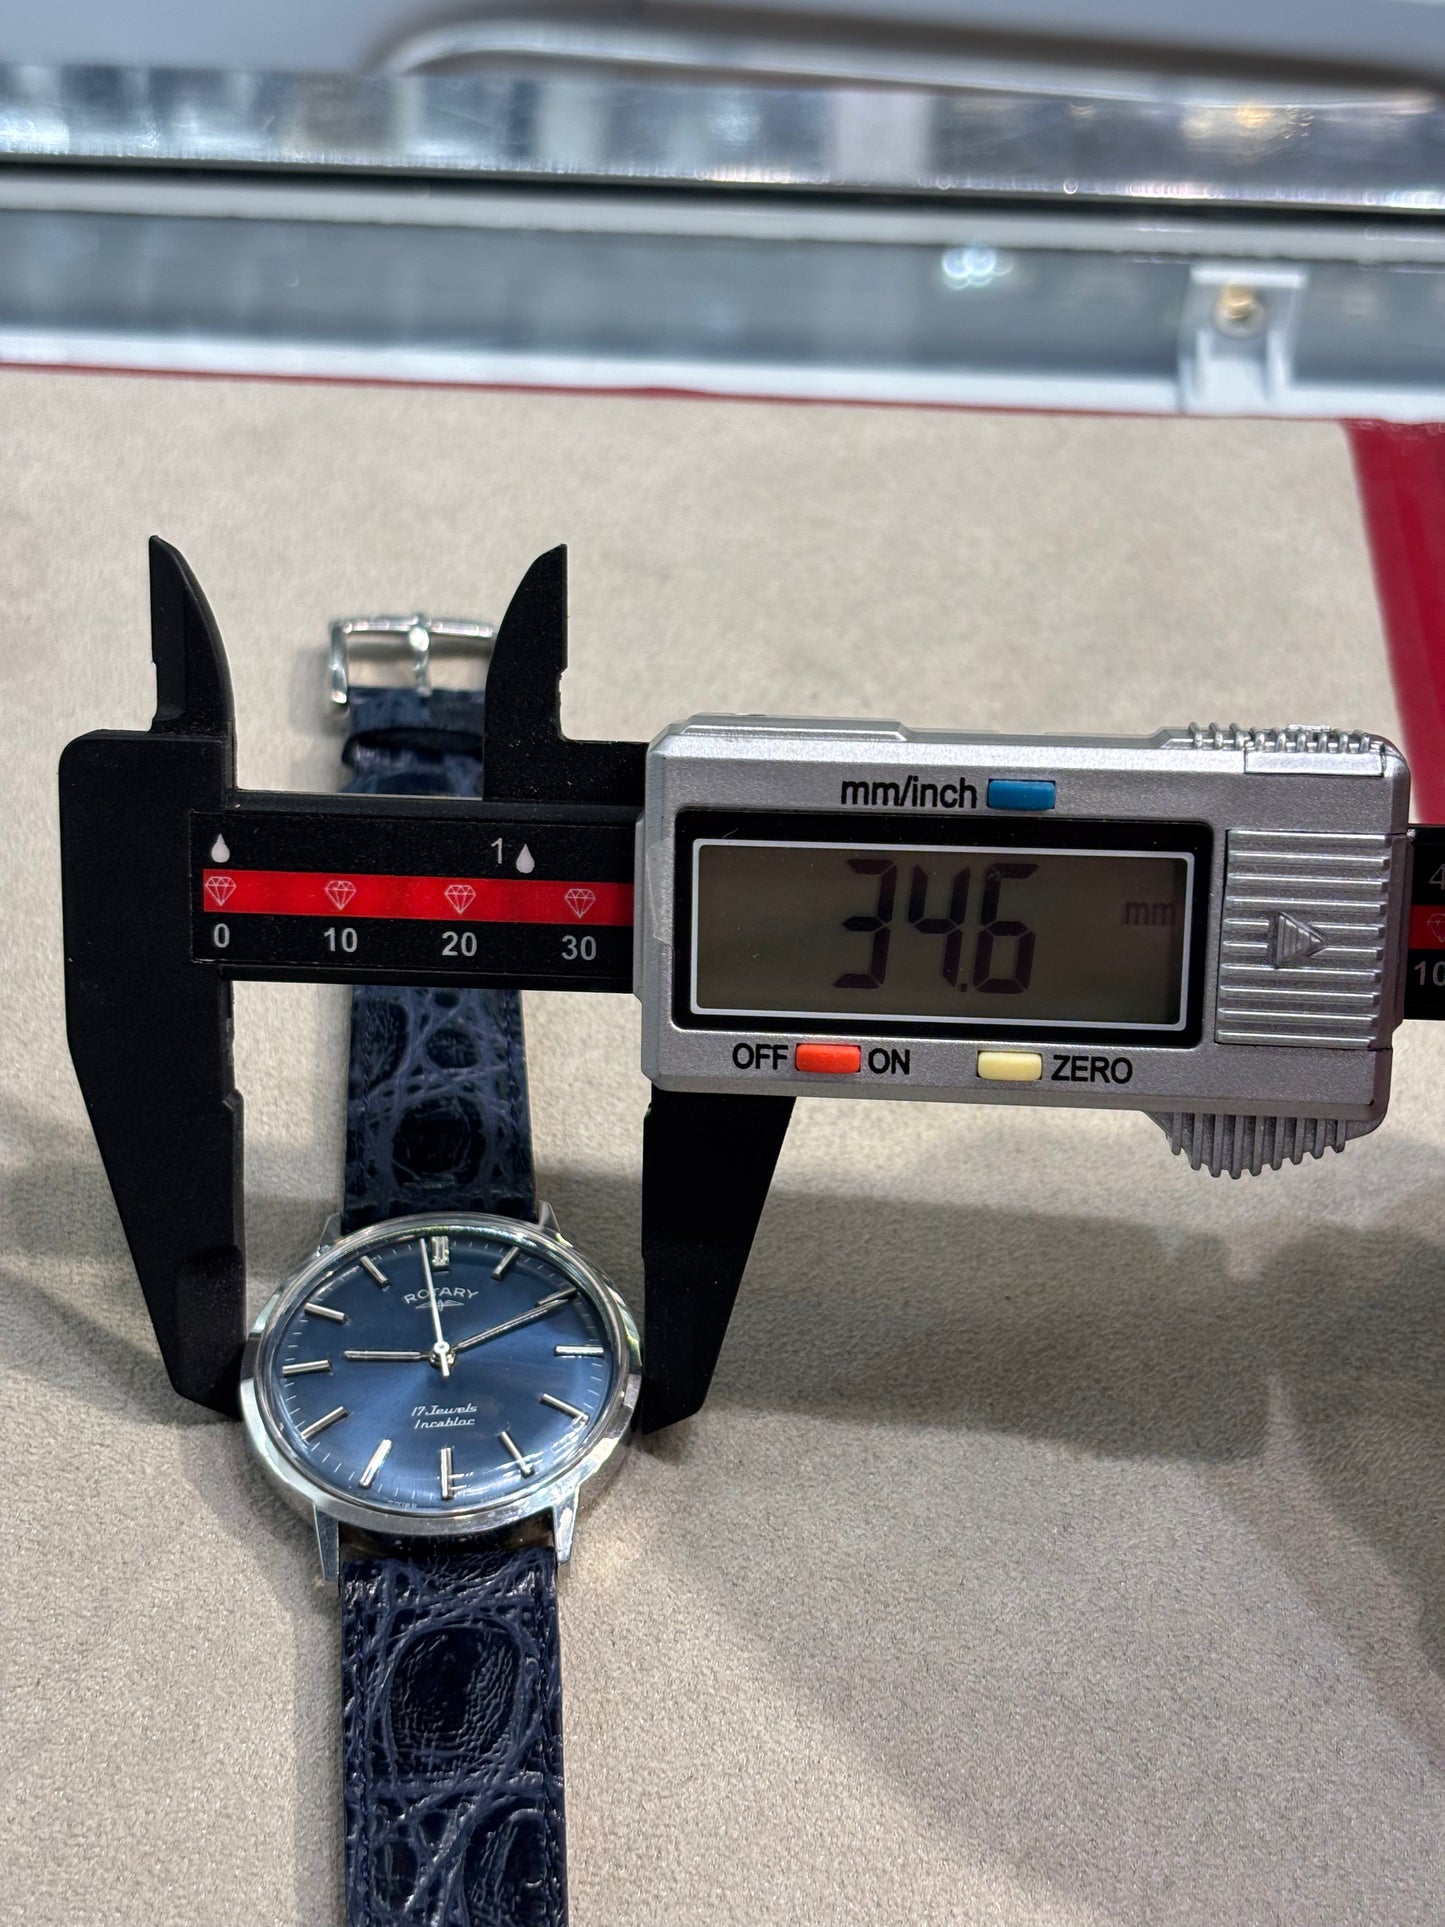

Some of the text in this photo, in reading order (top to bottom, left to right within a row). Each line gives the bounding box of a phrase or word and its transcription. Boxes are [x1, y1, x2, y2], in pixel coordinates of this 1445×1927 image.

[841, 775, 978, 809] mm/inch
[491, 838, 503, 864] 1
[213, 923, 597, 961] 0 10 20 30
[832, 859, 1177, 995] 34.6 mm
[732, 1043, 910, 1075] OFF ON
[1052, 1055, 1133, 1085] ZERO
[414, 1416, 475, 1430] Incabloc
